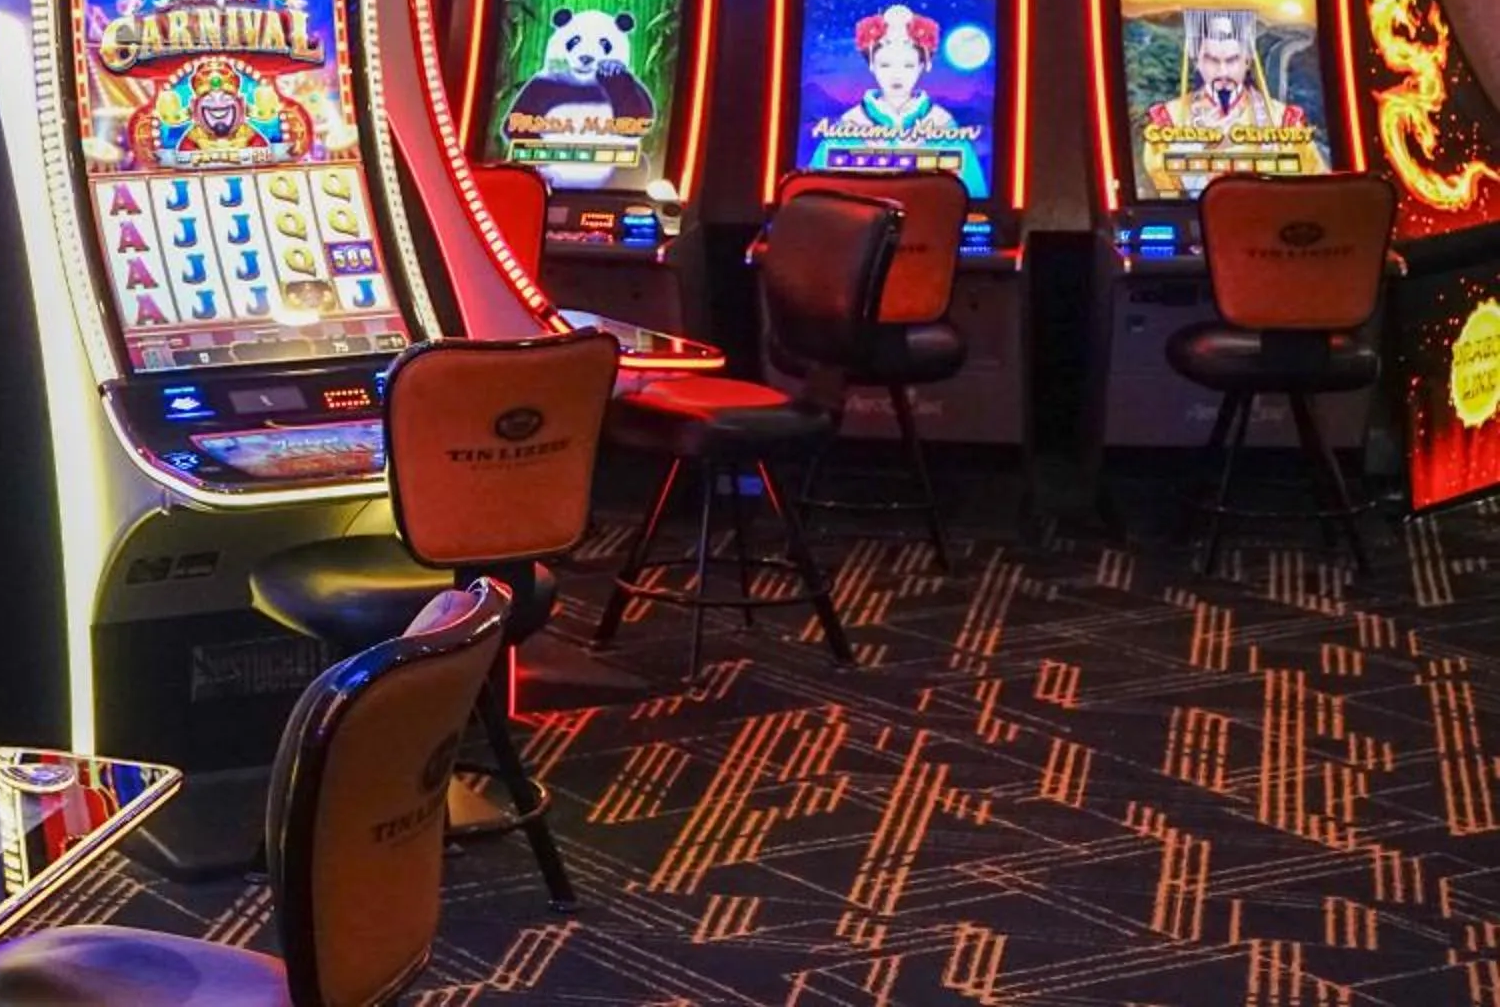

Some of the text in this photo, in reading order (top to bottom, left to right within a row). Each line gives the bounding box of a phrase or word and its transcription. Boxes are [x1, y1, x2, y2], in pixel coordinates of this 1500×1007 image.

[811, 116, 982, 143] Autumn Moon
[109, 183, 142, 216] A
[166, 180, 190, 211] J
[219, 177, 243, 207] J
[118, 221, 149, 253] A
[174, 217, 198, 247] J
[228, 213, 251, 244] J
[126, 257, 159, 290] A
[182, 253, 207, 284] J
[236, 249, 260, 280] J
[136, 279, 376, 325] A J J J
